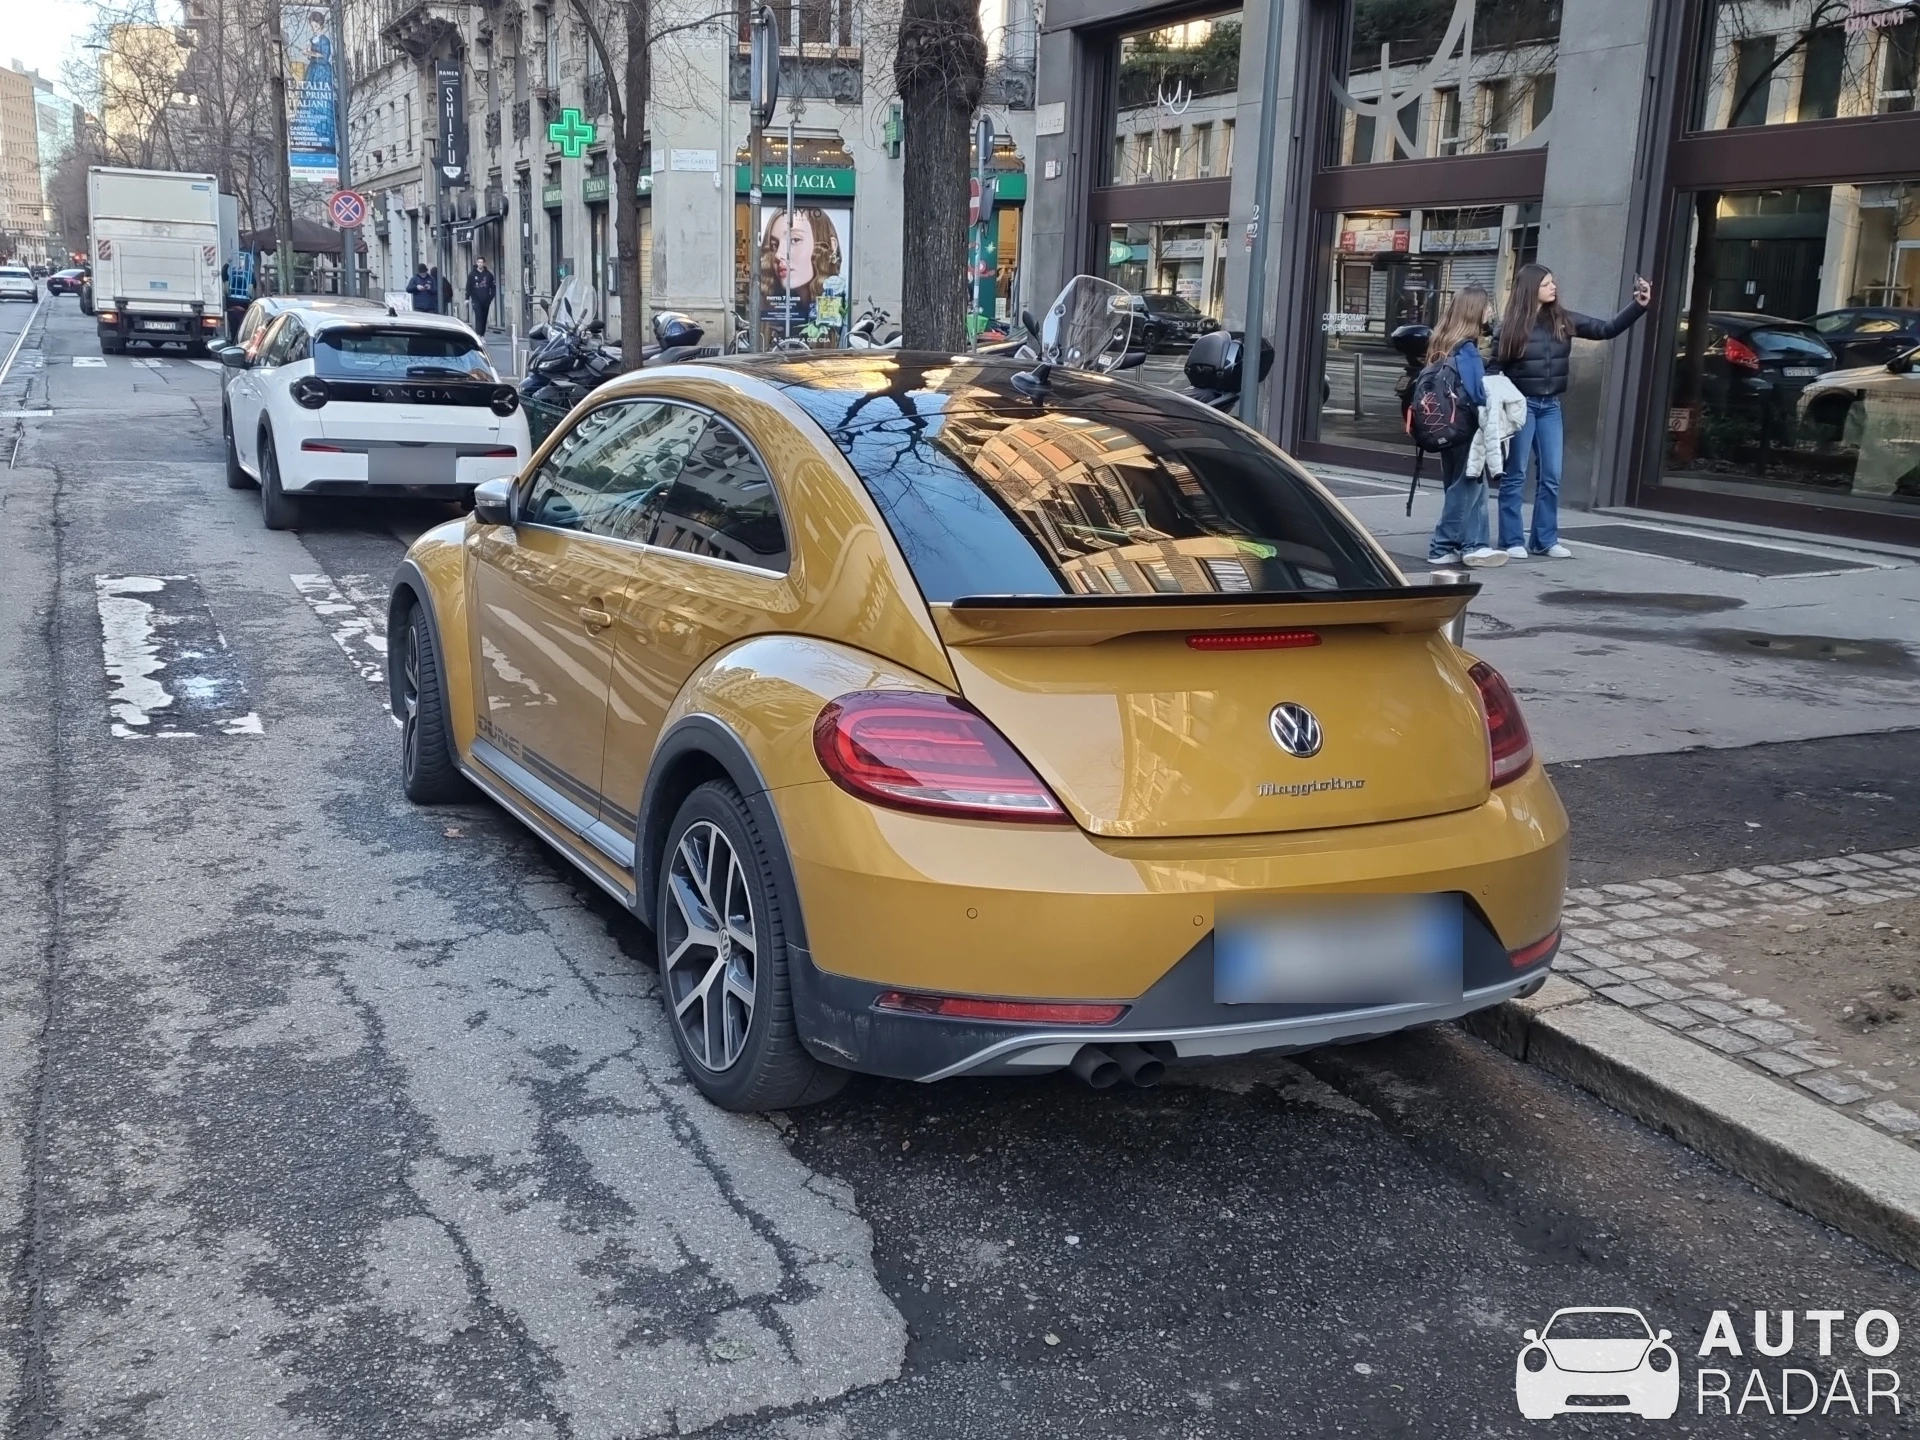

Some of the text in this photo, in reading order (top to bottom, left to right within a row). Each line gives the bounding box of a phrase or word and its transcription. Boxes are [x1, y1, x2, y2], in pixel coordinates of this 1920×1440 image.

[1844, 10, 1904, 33] DIMSUM
[287, 80, 331, 91] L'ITALIA
[288, 91, 332, 100] DEI PRIMI
[288, 99, 328, 108] ITALIANI
[446, 87, 456, 165] SHIFU
[761, 173, 836, 189] ARACIA
[1322, 312, 1367, 321] CONTEMPORARY
[371, 387, 452, 400] LANCIA
[477, 714, 521, 757] DUNE
[1256, 777, 1366, 797] Maggiolino
